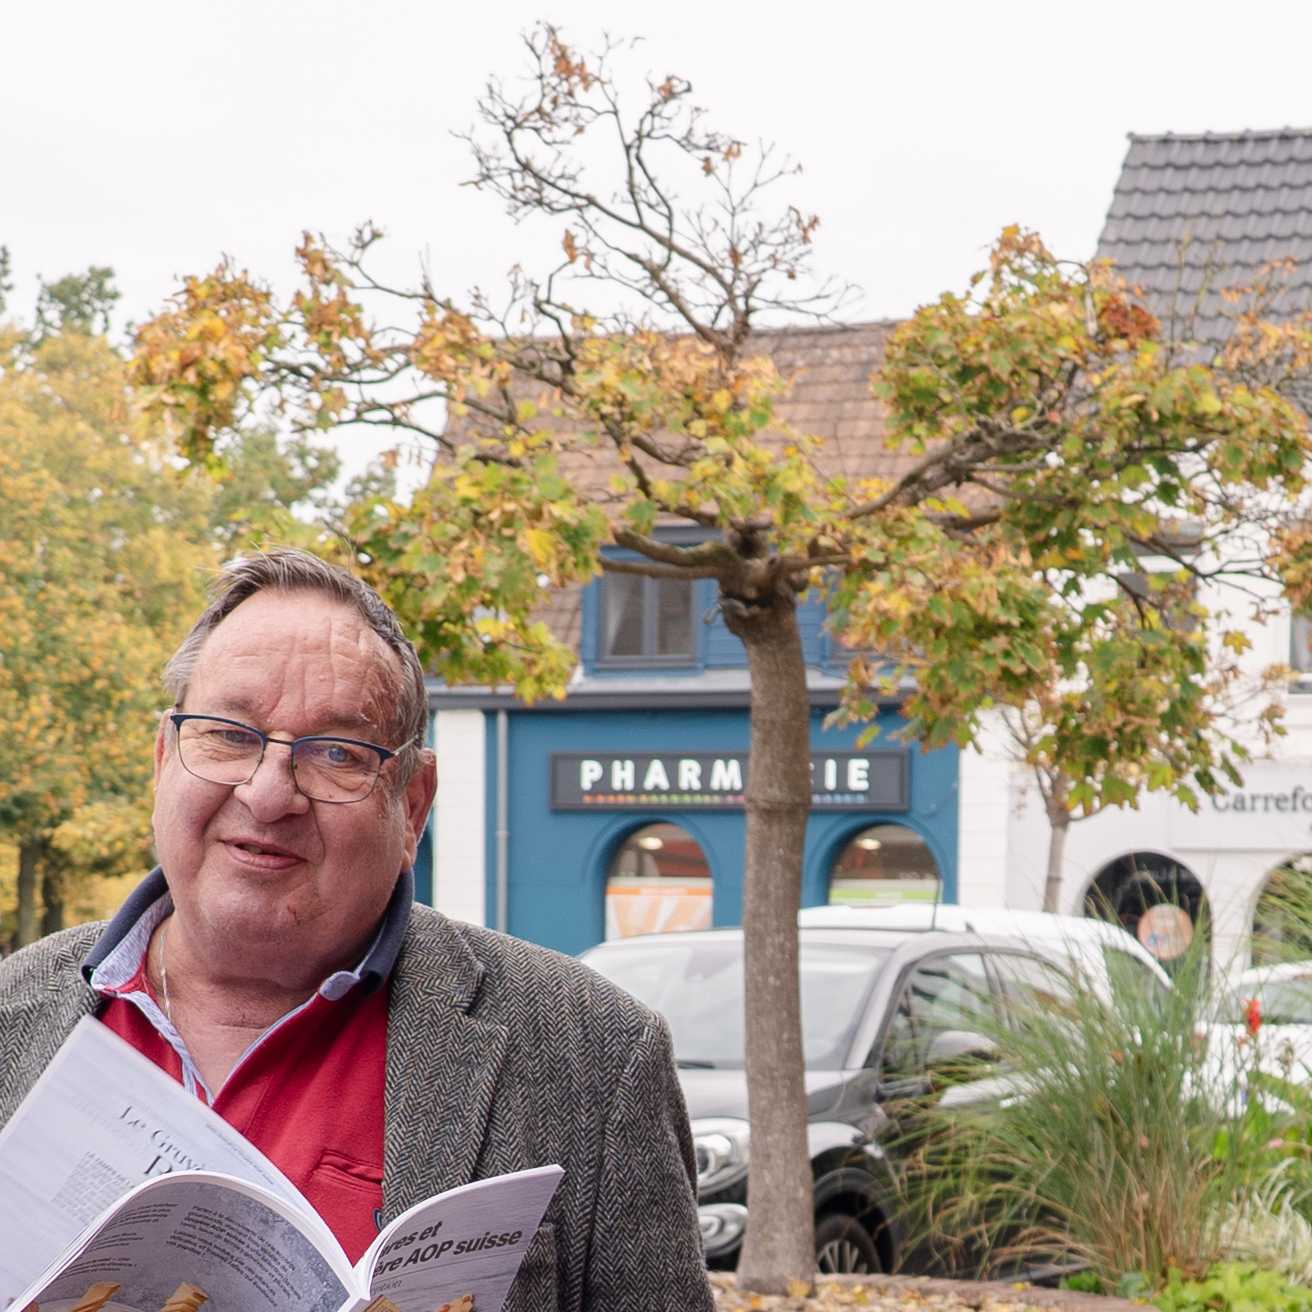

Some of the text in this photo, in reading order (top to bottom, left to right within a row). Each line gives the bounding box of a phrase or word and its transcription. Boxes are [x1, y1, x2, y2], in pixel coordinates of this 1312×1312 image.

[580, 759, 870, 790] PHARMIE
[119, 1105, 147, 1129] Le
[419, 1221, 443, 1240] et
[373, 1230, 522, 1277] ère AOP suisse
